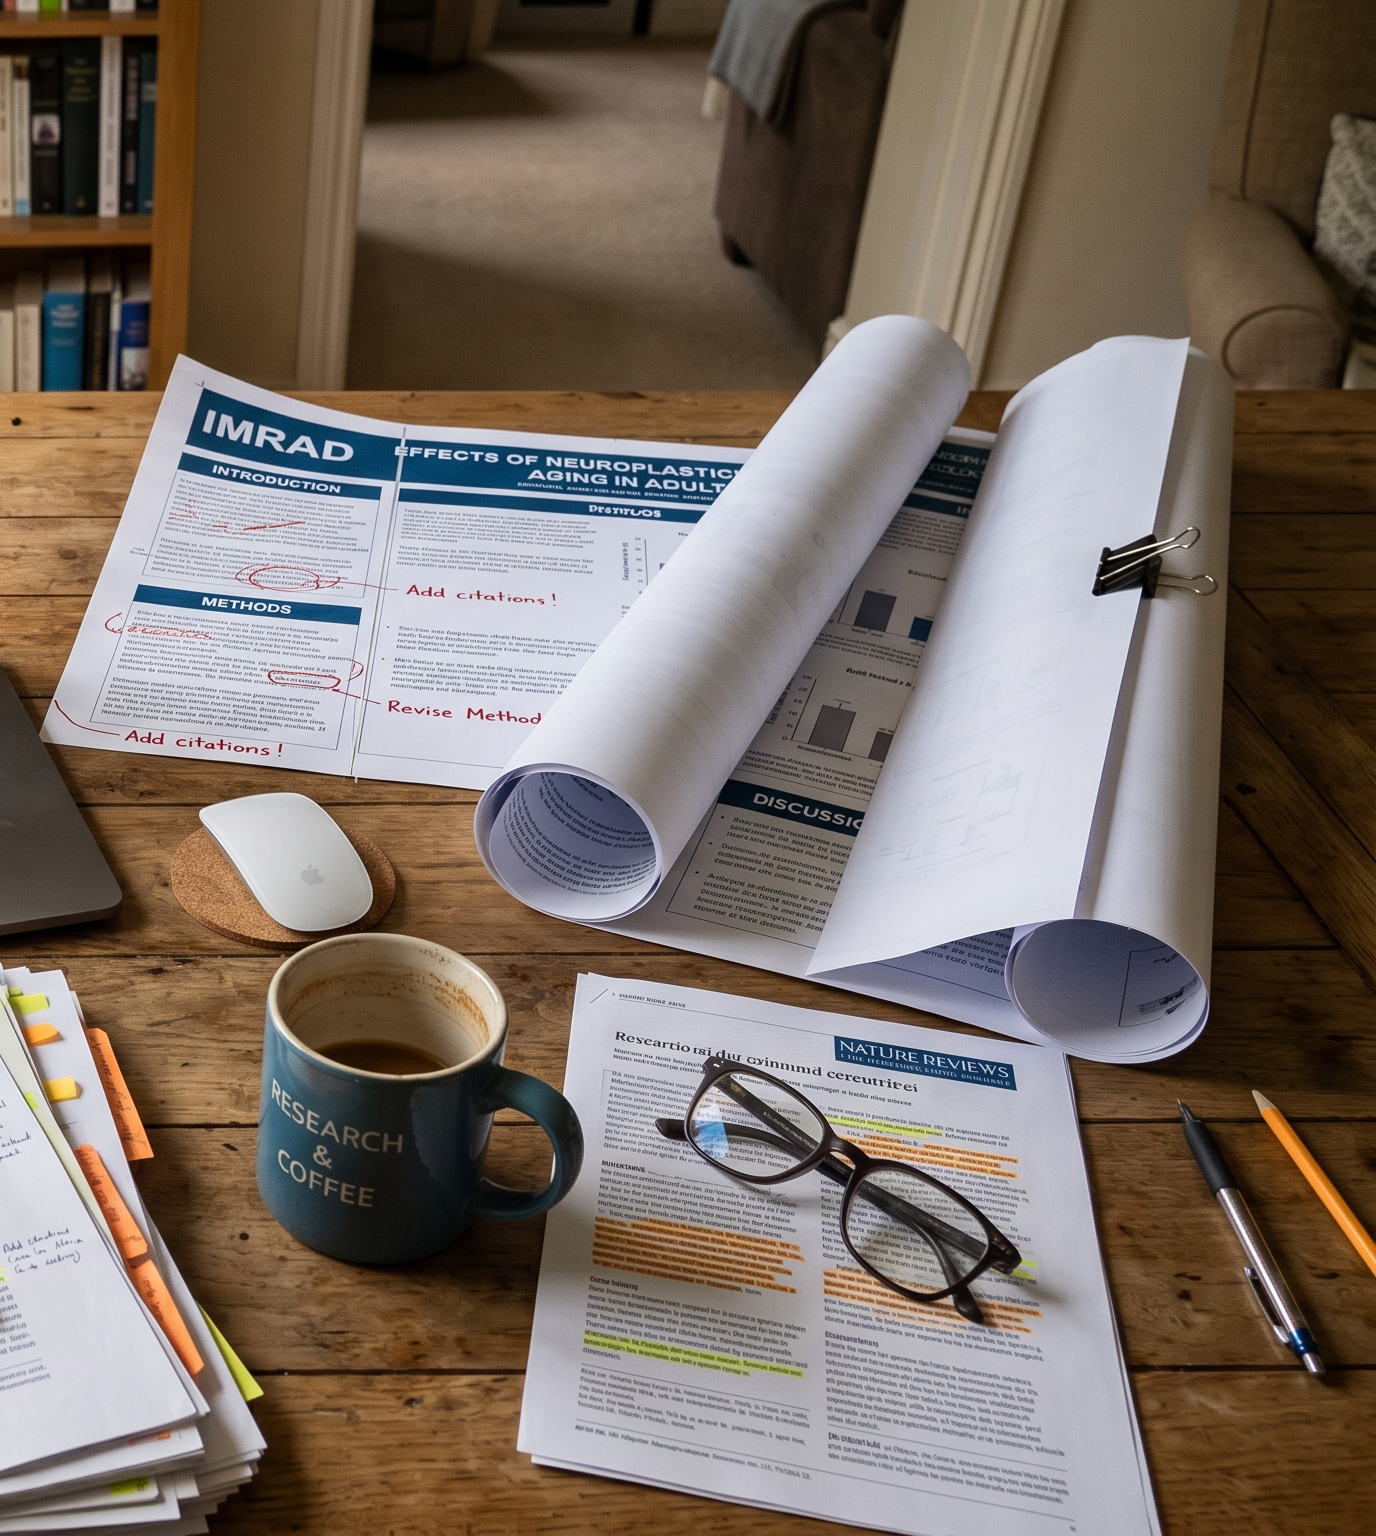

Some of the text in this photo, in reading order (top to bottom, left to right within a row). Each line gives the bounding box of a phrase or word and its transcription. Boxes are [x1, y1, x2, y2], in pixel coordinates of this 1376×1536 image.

[201, 409, 355, 462] IMRAD
[394, 446, 499, 464] EFFECTS
[506, 453, 539, 467] OF
[211, 464, 342, 494] INTRODUCTION
[527, 469, 728, 494] AGING IN ADULT
[406, 584, 446, 598] Add
[201, 596, 292, 616] METHODS
[388, 700, 453, 718] Revise
[124, 729, 164, 746] Add
[839, 1040, 919, 1064] NATURE
[923, 1054, 1009, 1078] REVIEWS
[271, 1078, 404, 1153] RESEARCH
[312, 1144, 333, 1170] &
[277, 1149, 375, 1208] COFFEE
